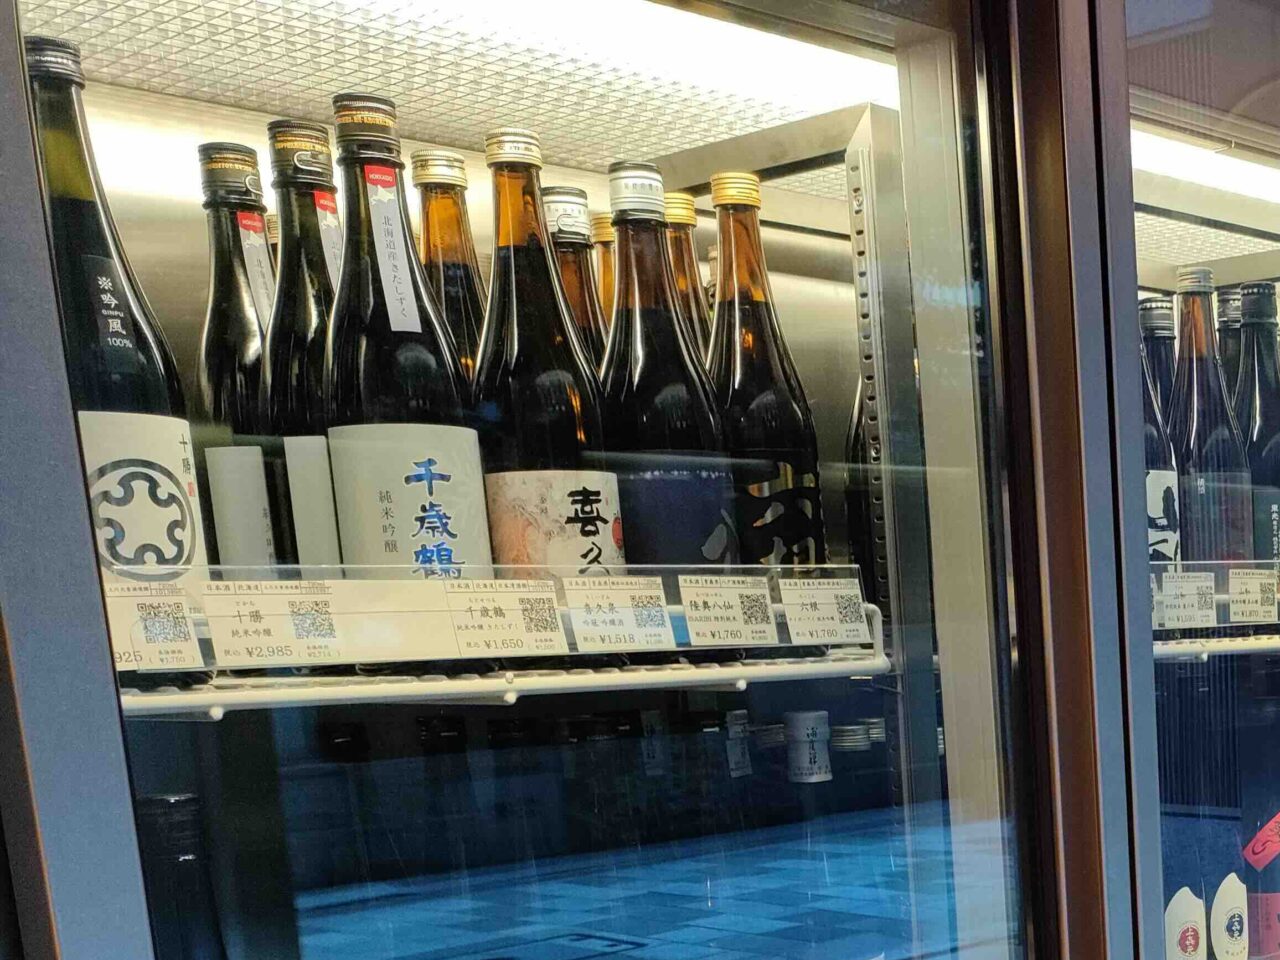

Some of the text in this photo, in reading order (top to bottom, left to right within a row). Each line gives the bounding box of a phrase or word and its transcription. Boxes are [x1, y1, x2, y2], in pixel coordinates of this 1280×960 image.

[107, 337, 133, 348] 100%
[379, 490, 399, 553] 純米吟醸
[404, 457, 465, 579] 千歳鶴
[584, 603, 620, 615] 喜久泉
[689, 600, 734, 612] 陸奥八仙
[232, 610, 264, 624] 十勝
[465, 606, 506, 620] 千歳鶴
[600, 634, 635, 644] ¥1,518
[710, 630, 742, 640] ¥1,760
[483, 638, 524, 650] ¥1,650
[248, 646, 294, 659] ¥2,985
